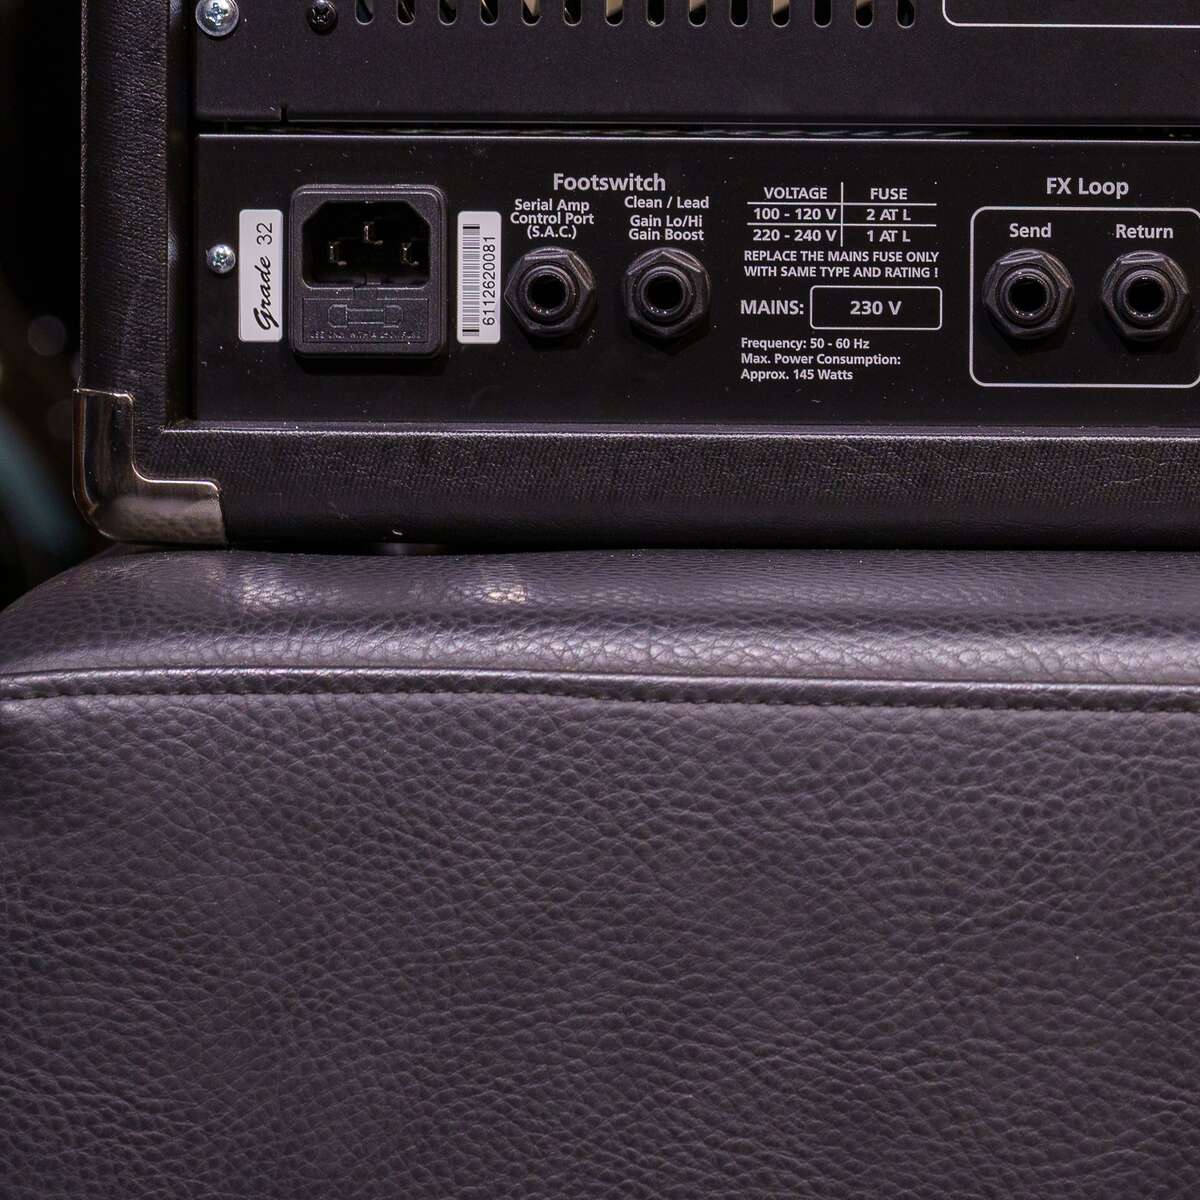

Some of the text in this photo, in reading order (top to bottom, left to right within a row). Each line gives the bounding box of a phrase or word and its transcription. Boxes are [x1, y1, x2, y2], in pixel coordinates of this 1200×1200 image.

[553, 172, 665, 191] Footswitch
[1046, 177, 1128, 199] FX Loop
[763, 186, 828, 200] VOLTAGE
[870, 187, 908, 200] FUSE
[514, 199, 589, 214] Serial Amp
[624, 195, 662, 208] Clean
[676, 195, 709, 208] Lead
[510, 212, 595, 225] Control Port
[629, 214, 702, 227] Gain Lo/Hi
[753, 207, 780, 220] 100
[794, 207, 821, 220] 120
[825, 208, 836, 220] V
[866, 208, 911, 220] 2 AT L
[526, 224, 576, 239] (S.A.C.)
[628, 227, 704, 240] Gain Boost
[752, 228, 780, 241] 220
[794, 229, 821, 241] 240
[825, 229, 837, 241] V
[866, 229, 910, 242] 1 AT L
[1009, 222, 1051, 237] Send
[1115, 223, 1173, 238] Return
[744, 250, 939, 262] REPLACE THE MAINS FUSE ONLY
[253, 223, 279, 331] Grade 32
[743, 265, 776, 276] WITH
[780, 265, 816, 277] SAME
[819, 266, 850, 277] TYPE
[852, 266, 881, 277] AND
[884, 266, 930, 278] RATING
[481, 235, 496, 327] 6112620081
[740, 299, 902, 315] MAINS: 230 V
[741, 337, 806, 351] Frequency:
[810, 337, 824, 348] 50
[835, 337, 850, 349] 60
[853, 338, 870, 349] Hz
[741, 352, 900, 367] Max. Power Consumption:
[740, 368, 853, 382] Approx. 145 Watts
